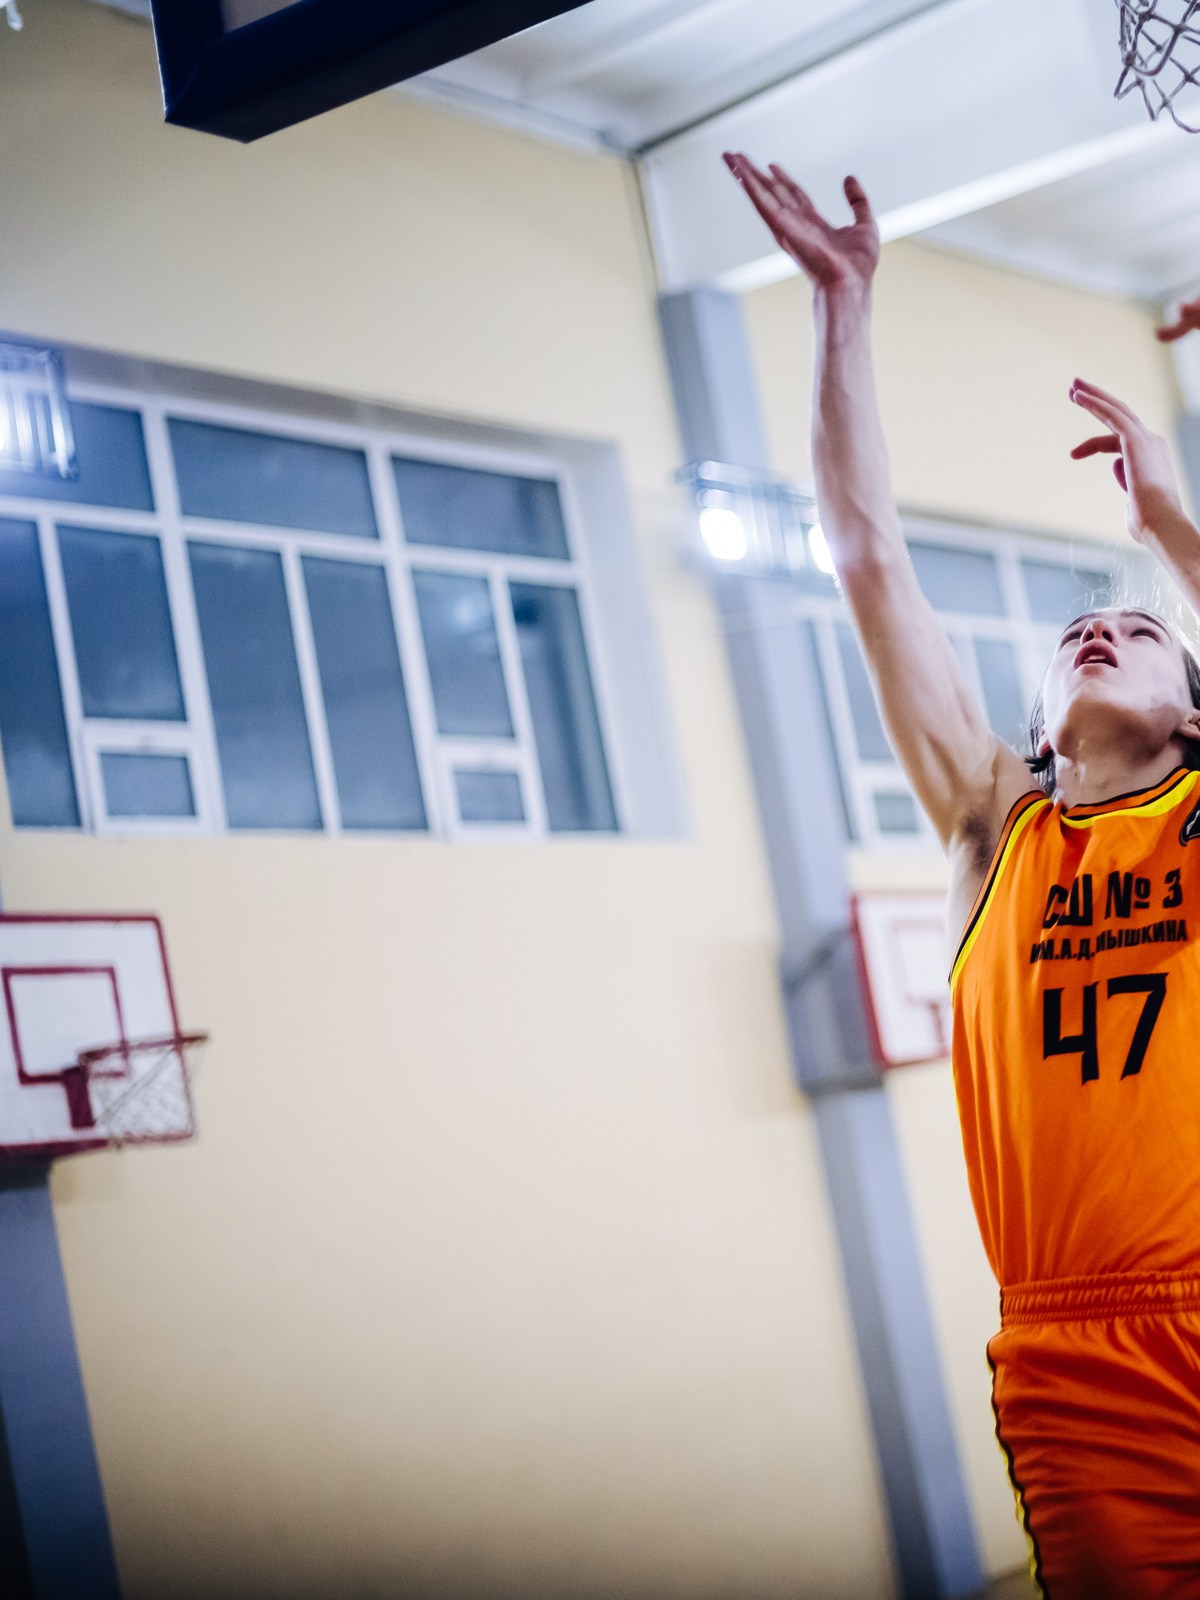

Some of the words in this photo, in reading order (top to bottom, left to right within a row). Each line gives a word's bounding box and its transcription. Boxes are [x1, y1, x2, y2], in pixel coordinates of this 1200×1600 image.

[1042, 873, 1093, 929] СШ
[1163, 867, 1183, 909] 3
[1043, 972, 1169, 1086] 47
